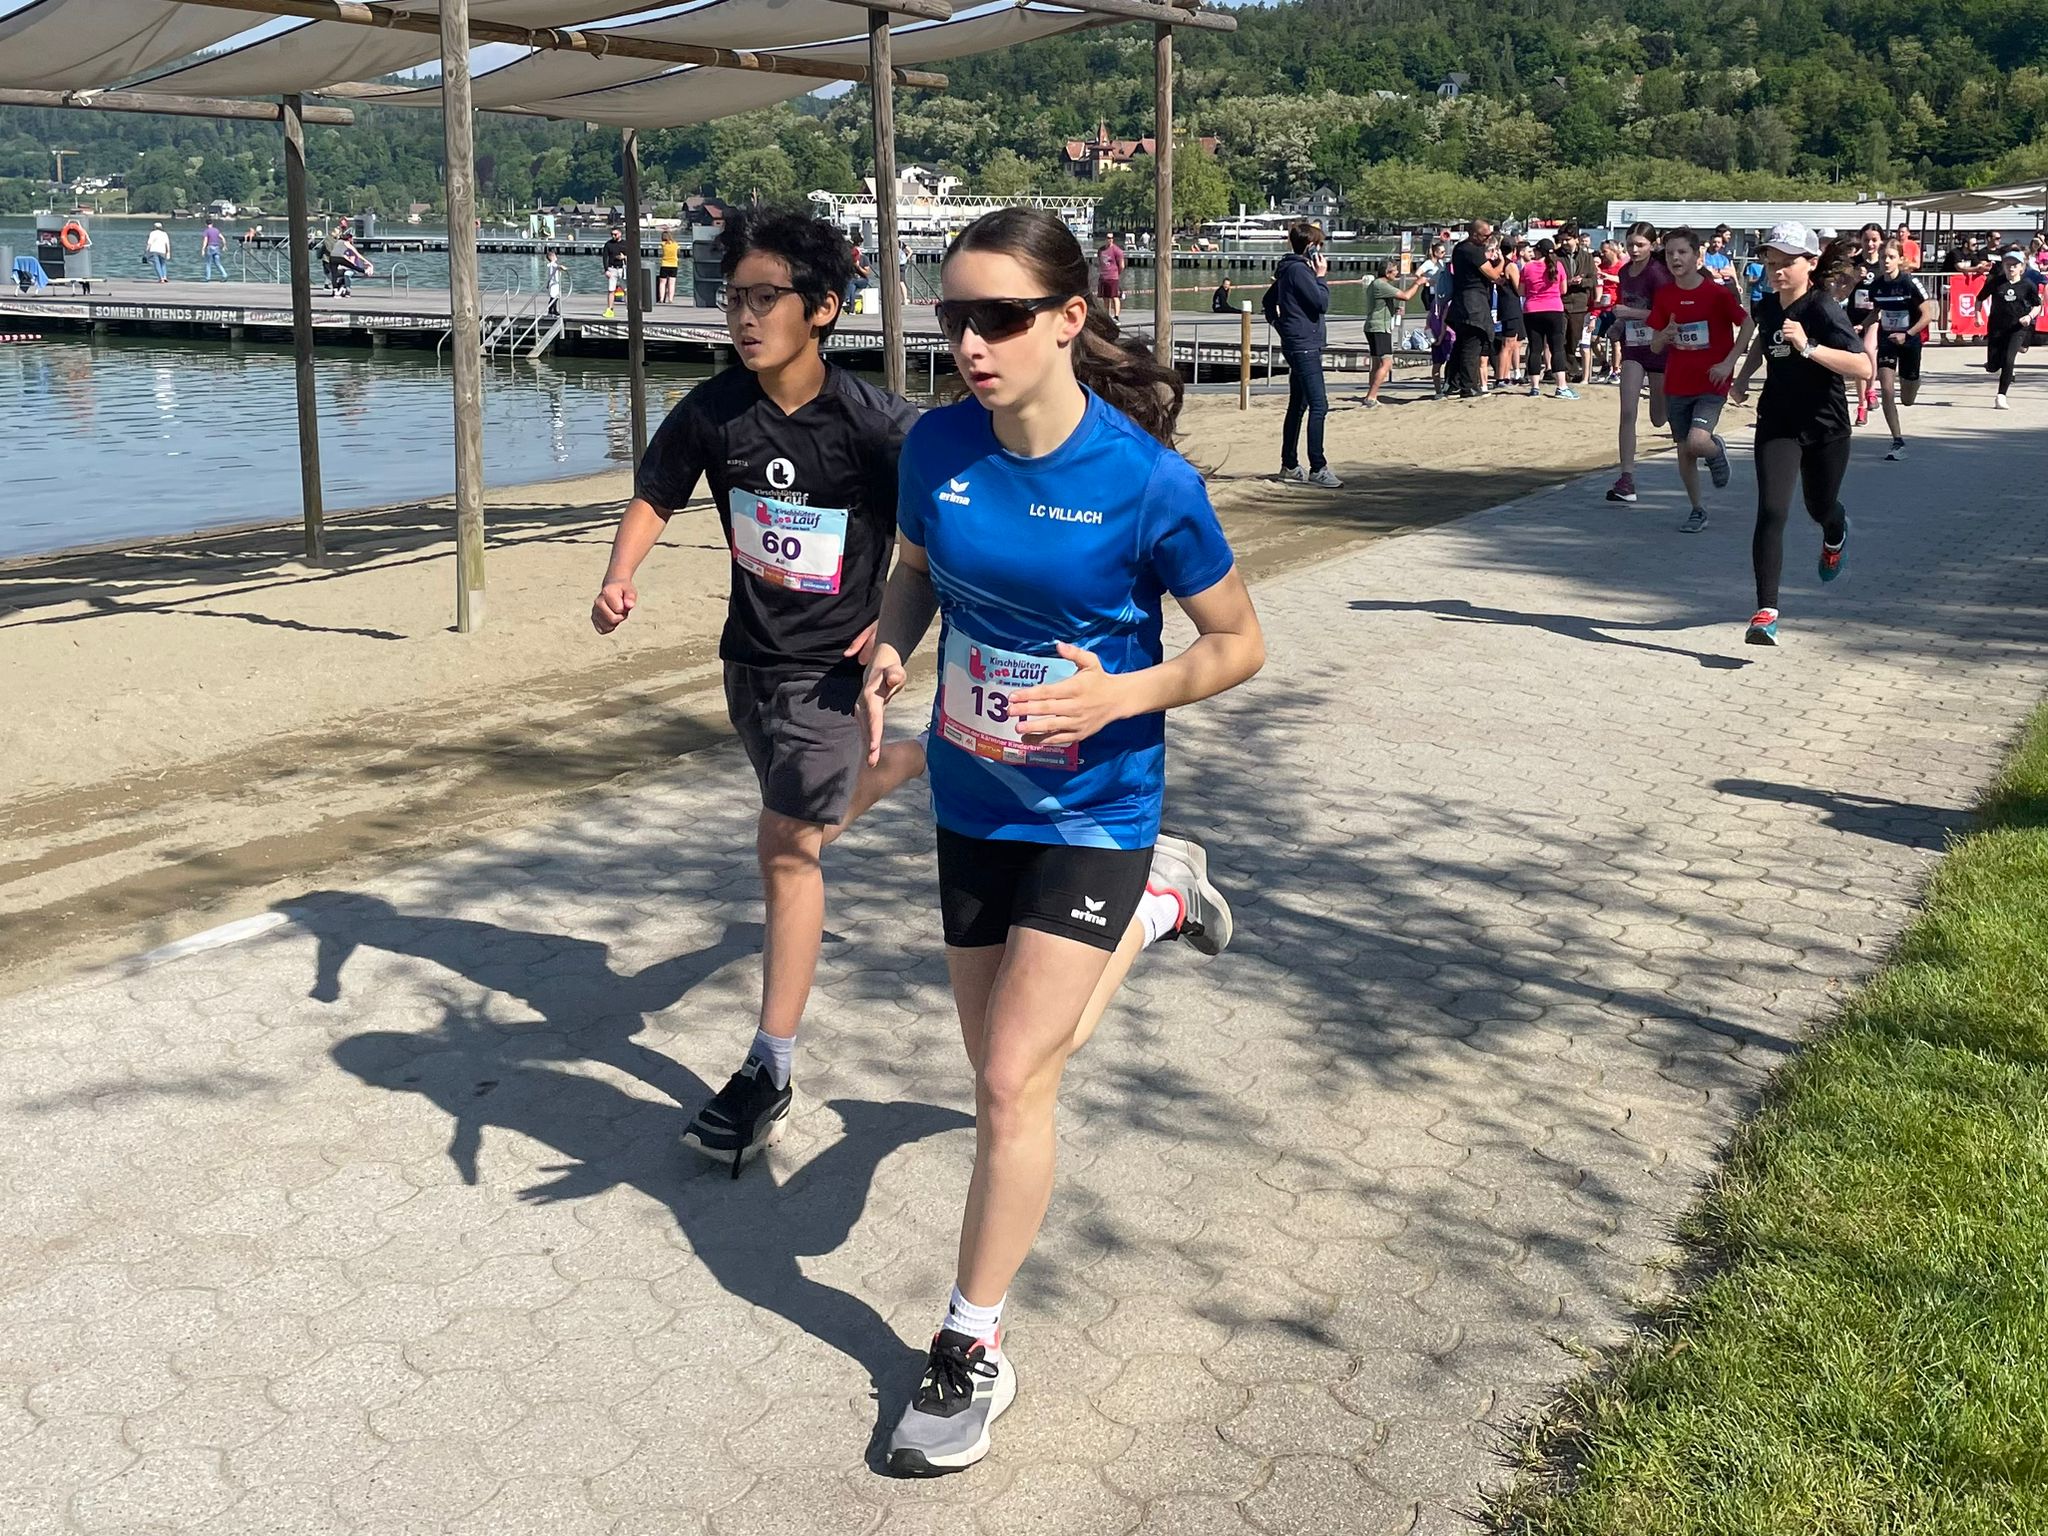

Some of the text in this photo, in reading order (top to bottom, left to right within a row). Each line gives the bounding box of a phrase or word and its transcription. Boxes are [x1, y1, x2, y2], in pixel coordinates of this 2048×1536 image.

[95, 306, 144, 318] SOMMER
[147, 307, 192, 320] TRENDS
[195, 310, 237, 321] FINDEN
[357, 315, 412, 327] SOMMER
[417, 318, 452, 328] TREN
[827, 334, 884, 348] TRENDS
[939, 491, 971, 506] erima
[1029, 503, 1103, 524] LC VILLACH
[793, 514, 822, 529] Lauf
[762, 530, 802, 561] 60
[990, 656, 1041, 670] Kirschblüten
[1012, 665, 1049, 685] Lauf
[971, 685, 1028, 723] 13
[1071, 908, 1107, 927] erima
